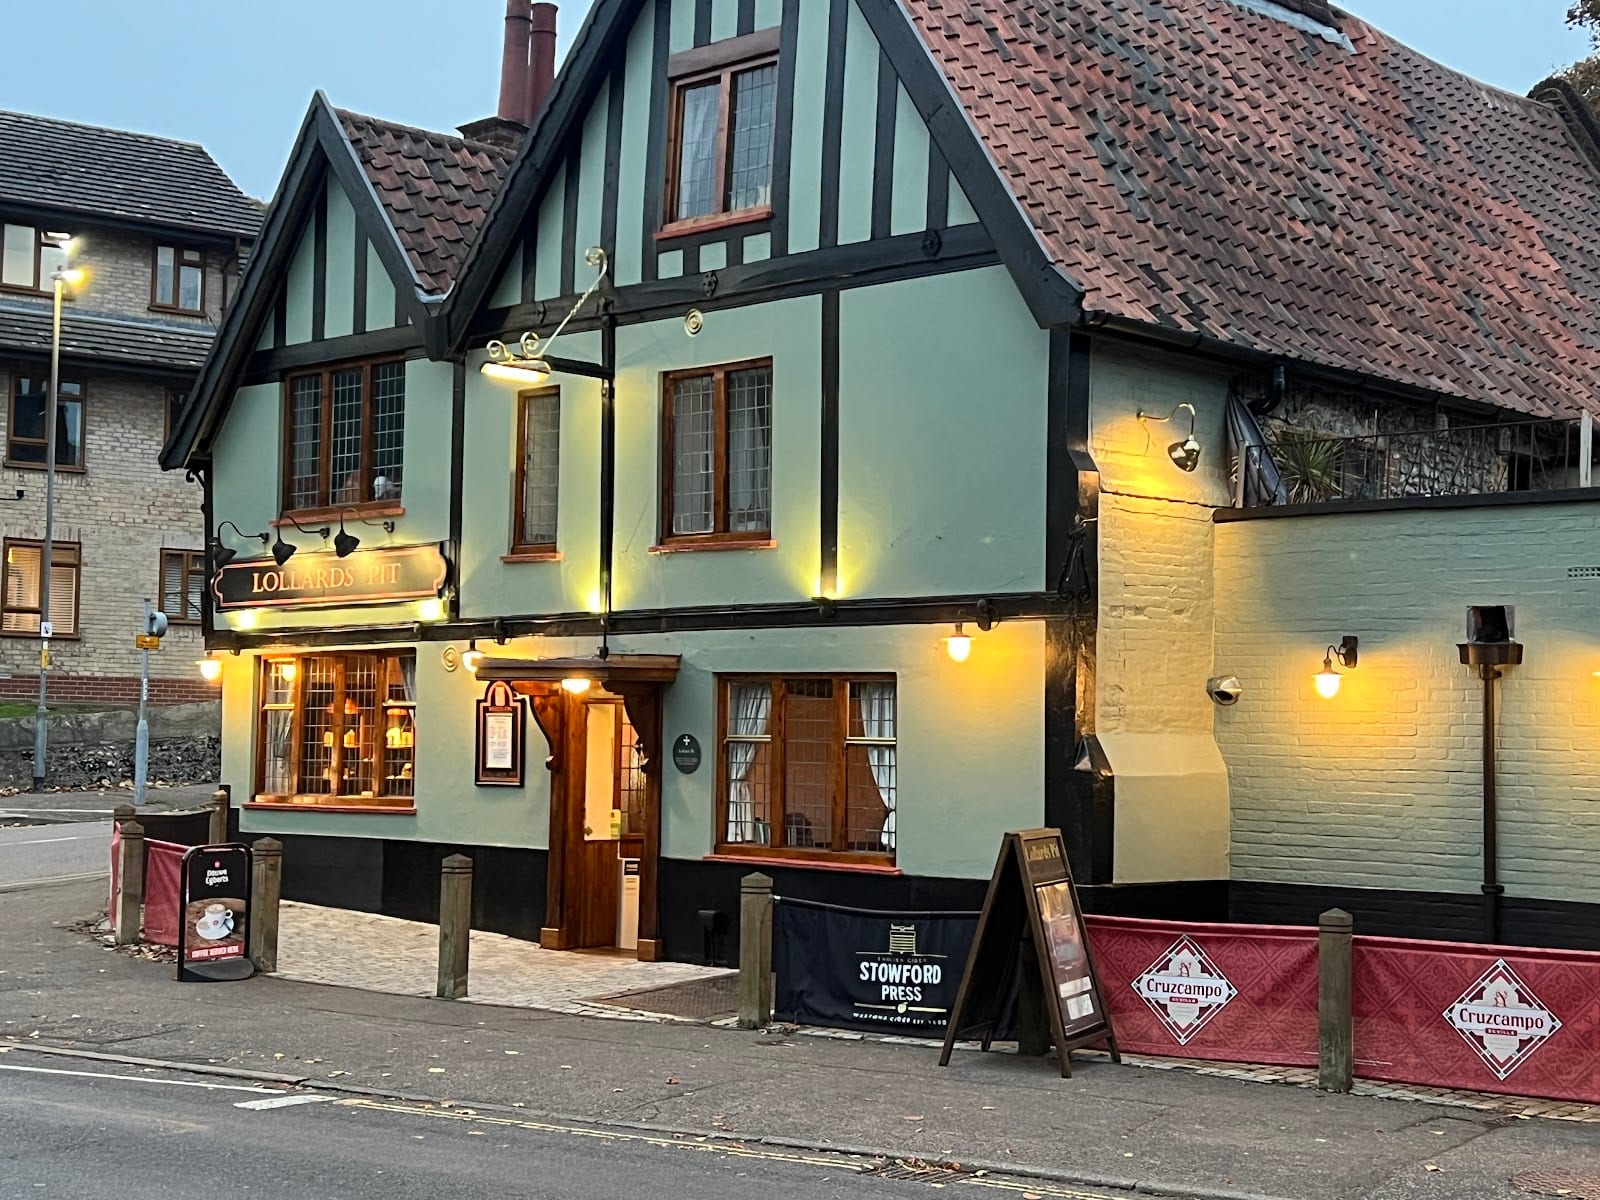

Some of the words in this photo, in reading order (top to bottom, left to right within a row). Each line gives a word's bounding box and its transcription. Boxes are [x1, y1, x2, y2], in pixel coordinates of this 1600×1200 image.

[252, 566, 355, 593] LOLLARDS
[368, 563, 401, 585] PIT
[859, 961, 942, 984] STOWFORD
[881, 984, 922, 1002] PRESS
[1146, 978, 1222, 998] Cruzcampo
[1460, 1008, 1544, 1030] Cruzcampo
